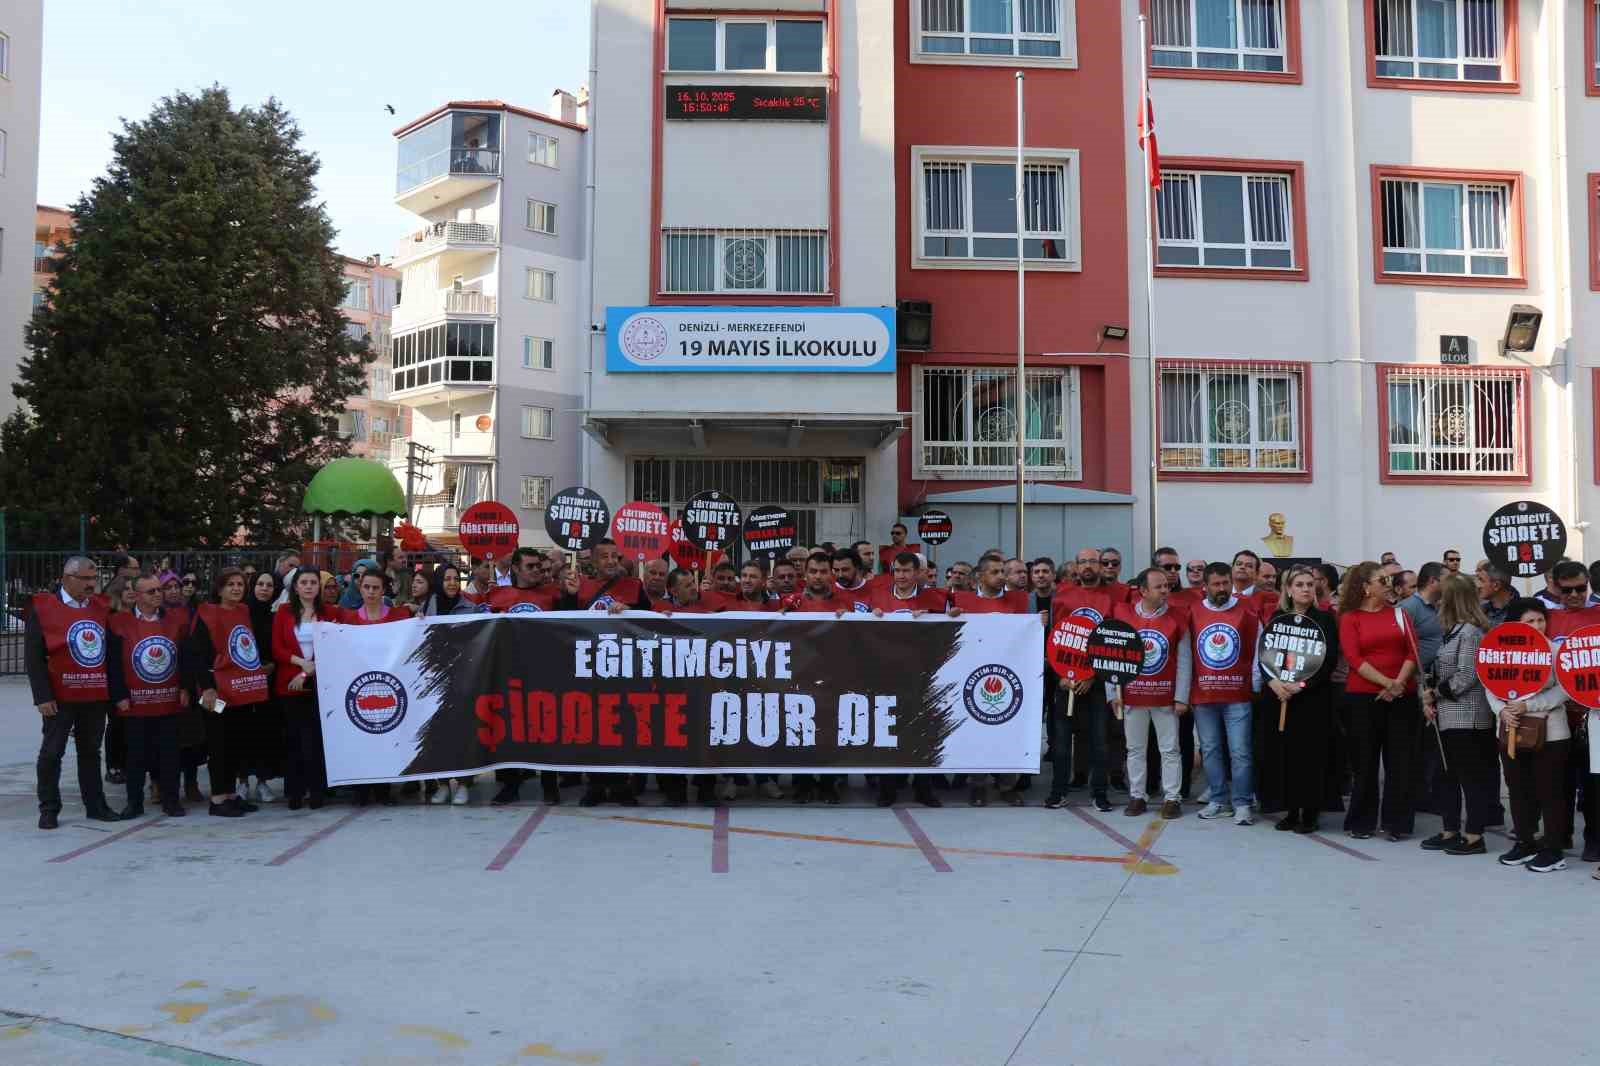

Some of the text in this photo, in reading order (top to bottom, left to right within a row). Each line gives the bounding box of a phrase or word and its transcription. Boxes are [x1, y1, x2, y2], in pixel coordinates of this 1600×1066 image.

[679, 321, 719, 332] DENİZLİ
[727, 321, 806, 333] MERKEZEFENDİ
[679, 336, 877, 357] 19 MAYIS İLKOKULU
[1449, 338, 1460, 352] A
[1441, 353, 1468, 361] BLOK
[550, 505, 605, 523] ŞİDDETE
[687, 509, 740, 525] ŞİDDETE
[1488, 524, 1561, 546] ŞİDDETE
[1518, 562, 1537, 575] DE
[1061, 622, 1093, 637] EĞİTİMC
[1053, 630, 1088, 653] ŞİDDE
[1264, 633, 1323, 656] ŞİDDETE
[574, 633, 792, 679] EĞİTİMCİYE
[1560, 648, 1600, 672] ŞİDD
[1280, 670, 1296, 682] DE
[474, 678, 898, 752] ŞİDDETE DUR DE
